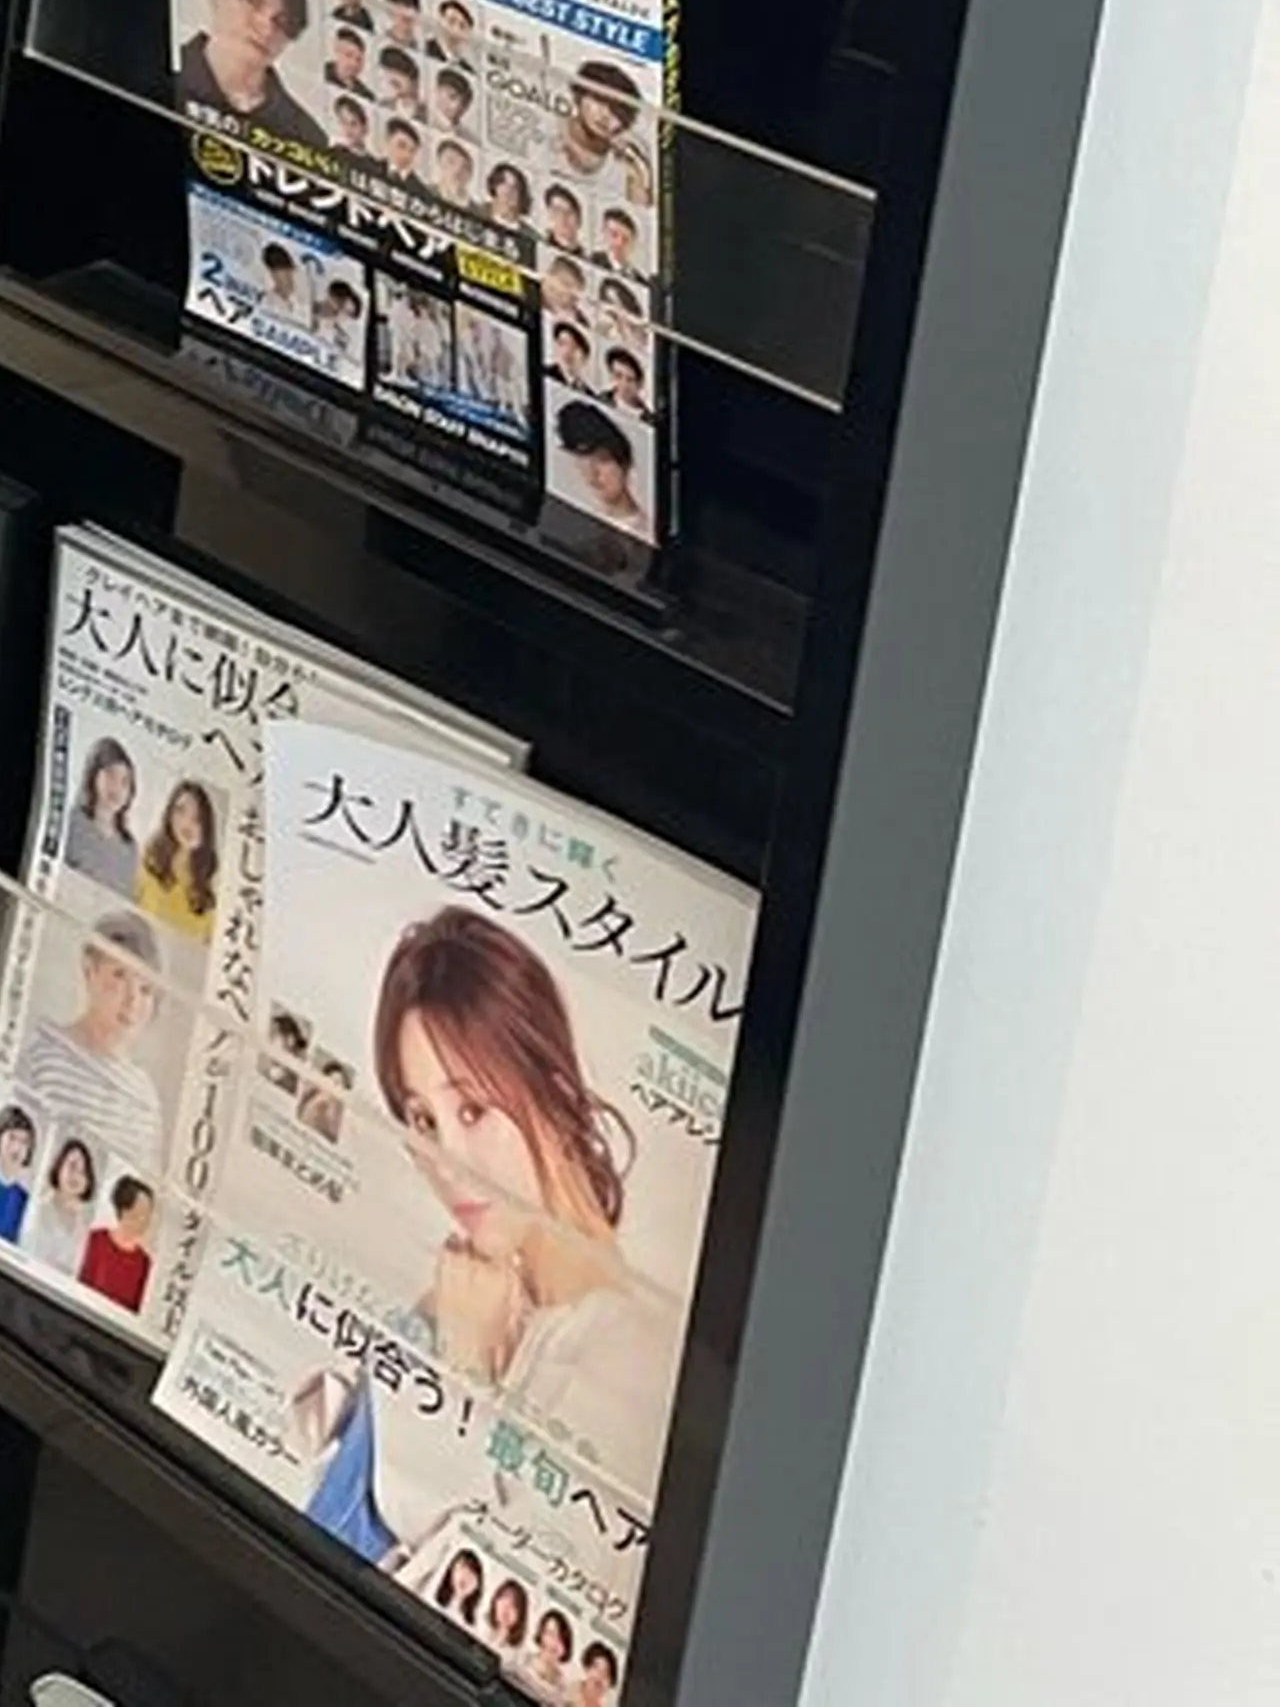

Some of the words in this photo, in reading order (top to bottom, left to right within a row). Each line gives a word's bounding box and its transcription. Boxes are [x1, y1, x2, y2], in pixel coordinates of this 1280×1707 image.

[569, 2, 652, 55] STYLE
[62, 588, 301, 726] 大人に似合
[301, 773, 744, 1023] 大人髪スタイル
[220, 1234, 475, 1438] 大人に似合う!
